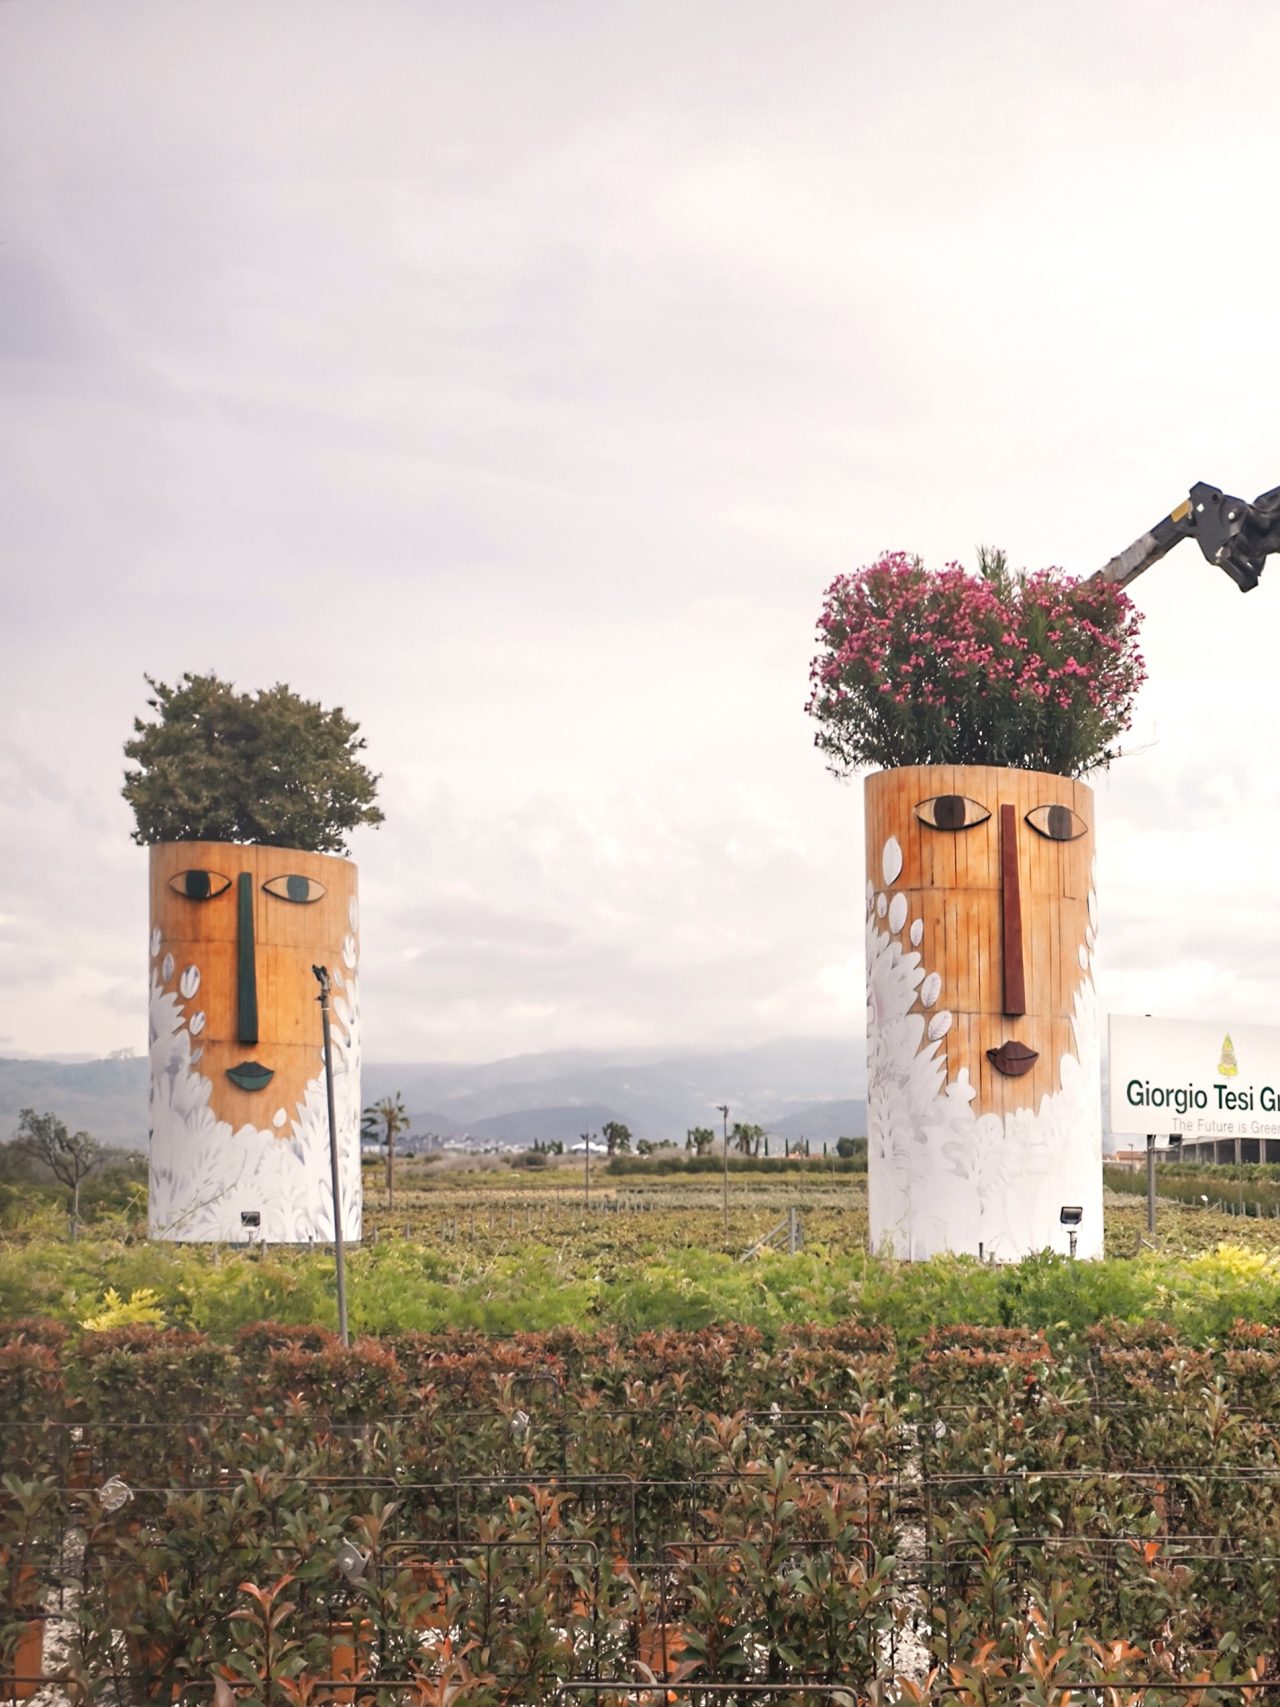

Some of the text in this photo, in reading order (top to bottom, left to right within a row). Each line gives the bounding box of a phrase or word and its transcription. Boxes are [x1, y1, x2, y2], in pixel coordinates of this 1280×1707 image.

[1126, 1079, 1208, 1114] Giorgio
[1213, 1084, 1254, 1111] Tesi
[1171, 1117, 1193, 1132] The
[1197, 1118, 1234, 1133] Future
[1238, 1120, 1248, 1133] is
